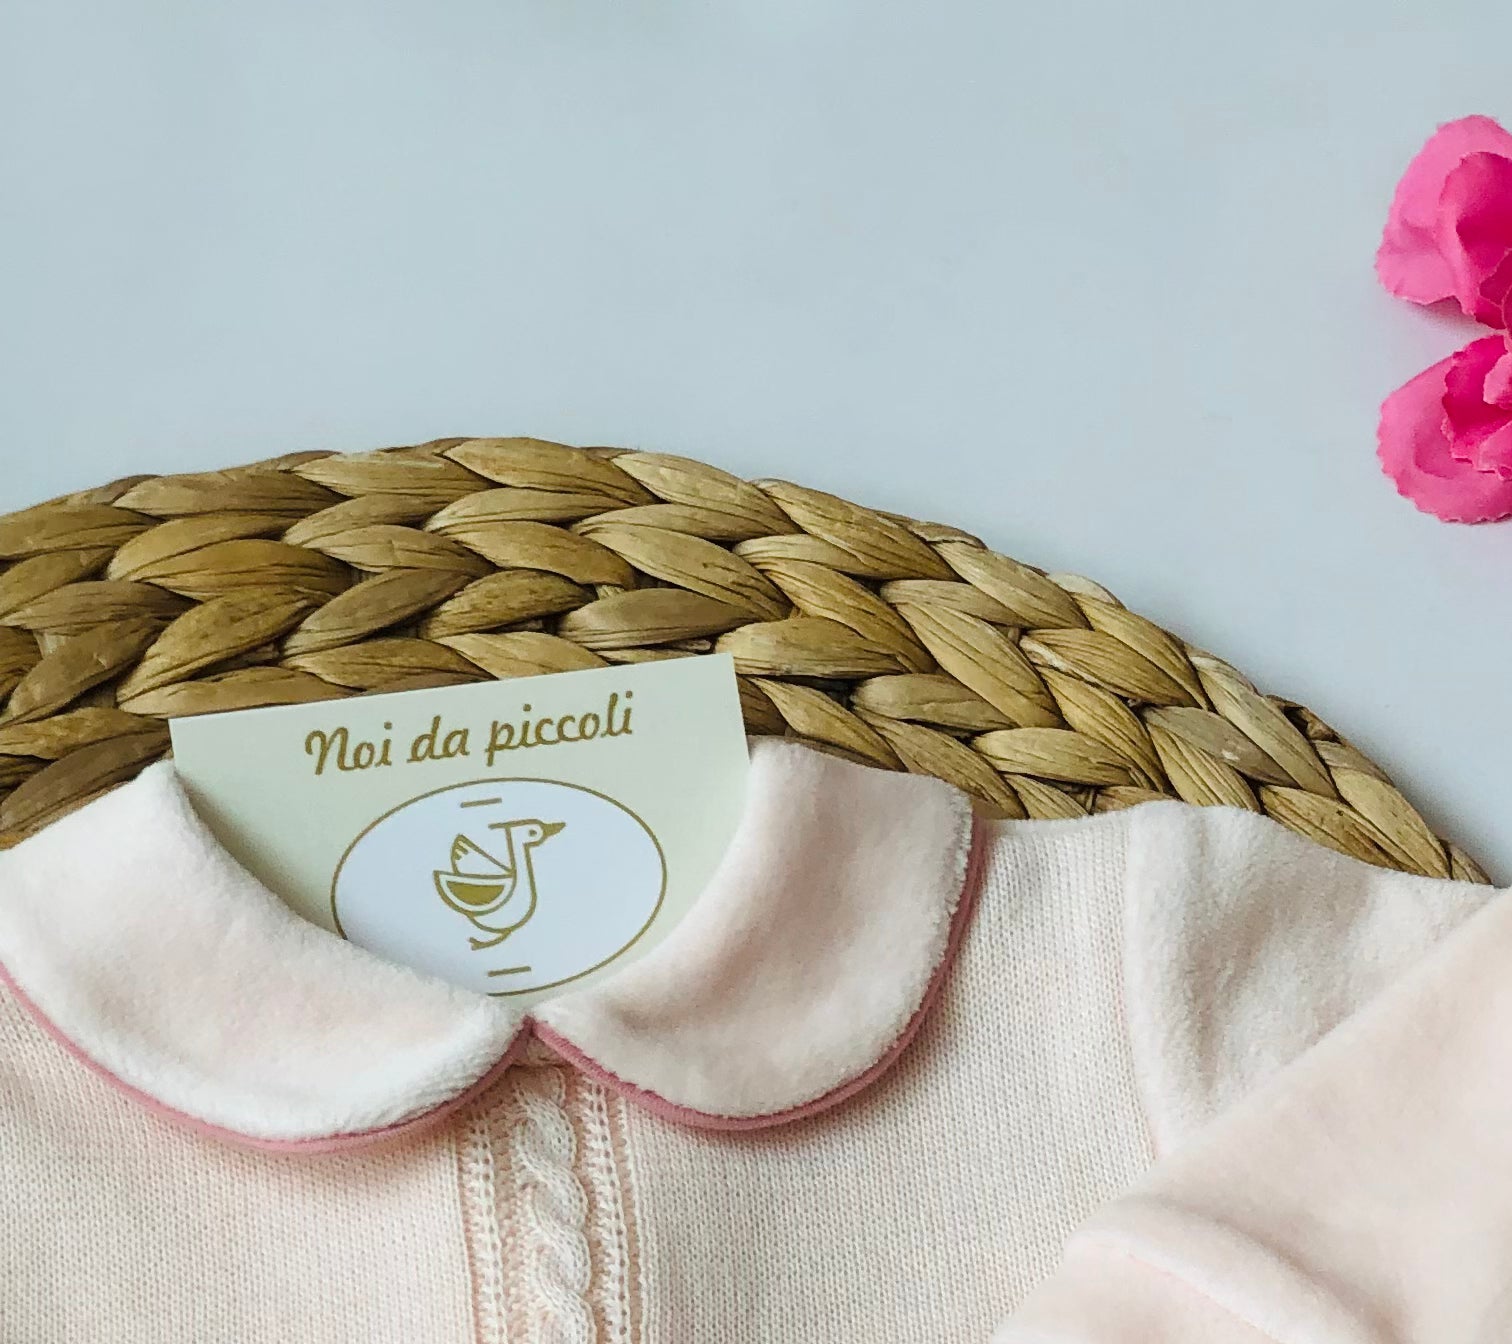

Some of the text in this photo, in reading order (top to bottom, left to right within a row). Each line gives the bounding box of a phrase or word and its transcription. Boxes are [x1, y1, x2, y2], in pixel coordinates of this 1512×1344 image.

[305, 690, 634, 775] Noi da piccoli
